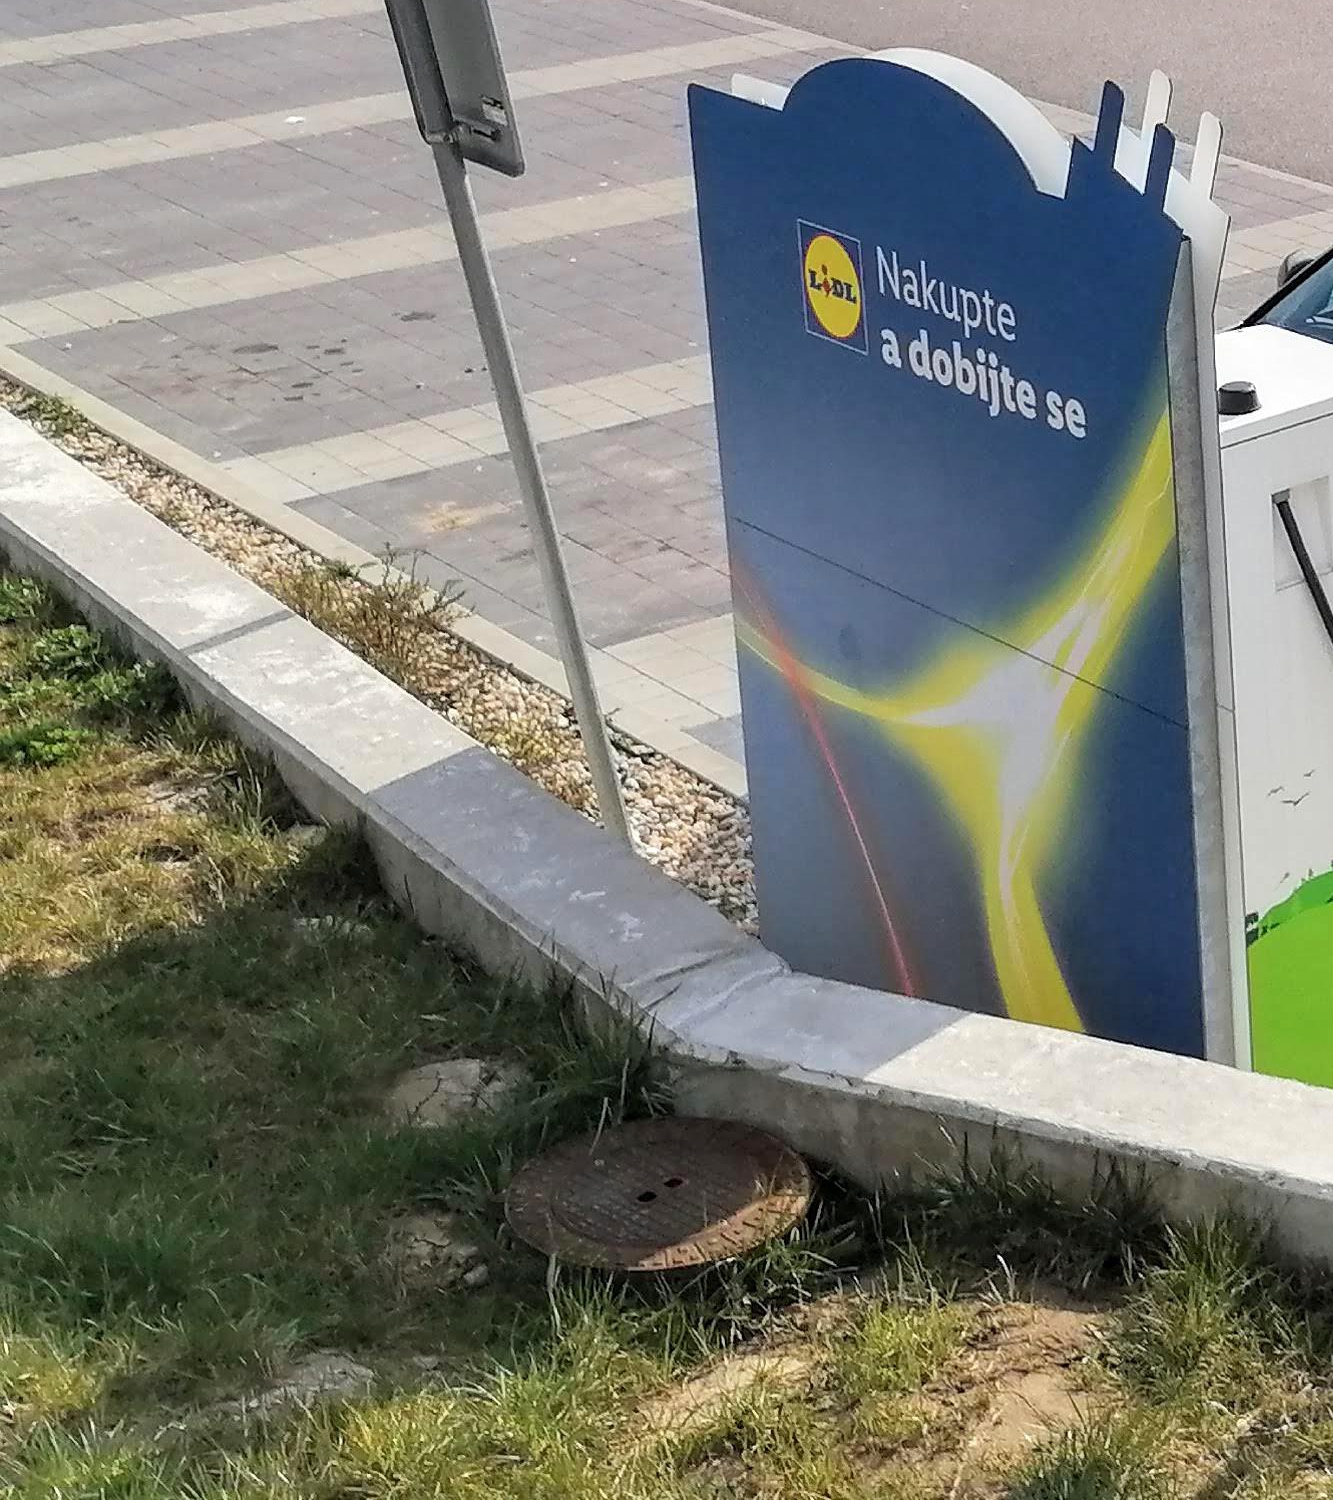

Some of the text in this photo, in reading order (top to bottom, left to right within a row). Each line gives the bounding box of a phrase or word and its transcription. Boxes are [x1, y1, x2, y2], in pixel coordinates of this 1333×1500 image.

[875, 244, 1018, 342] Nakupte
[881, 327, 1088, 439] a dobijte se
